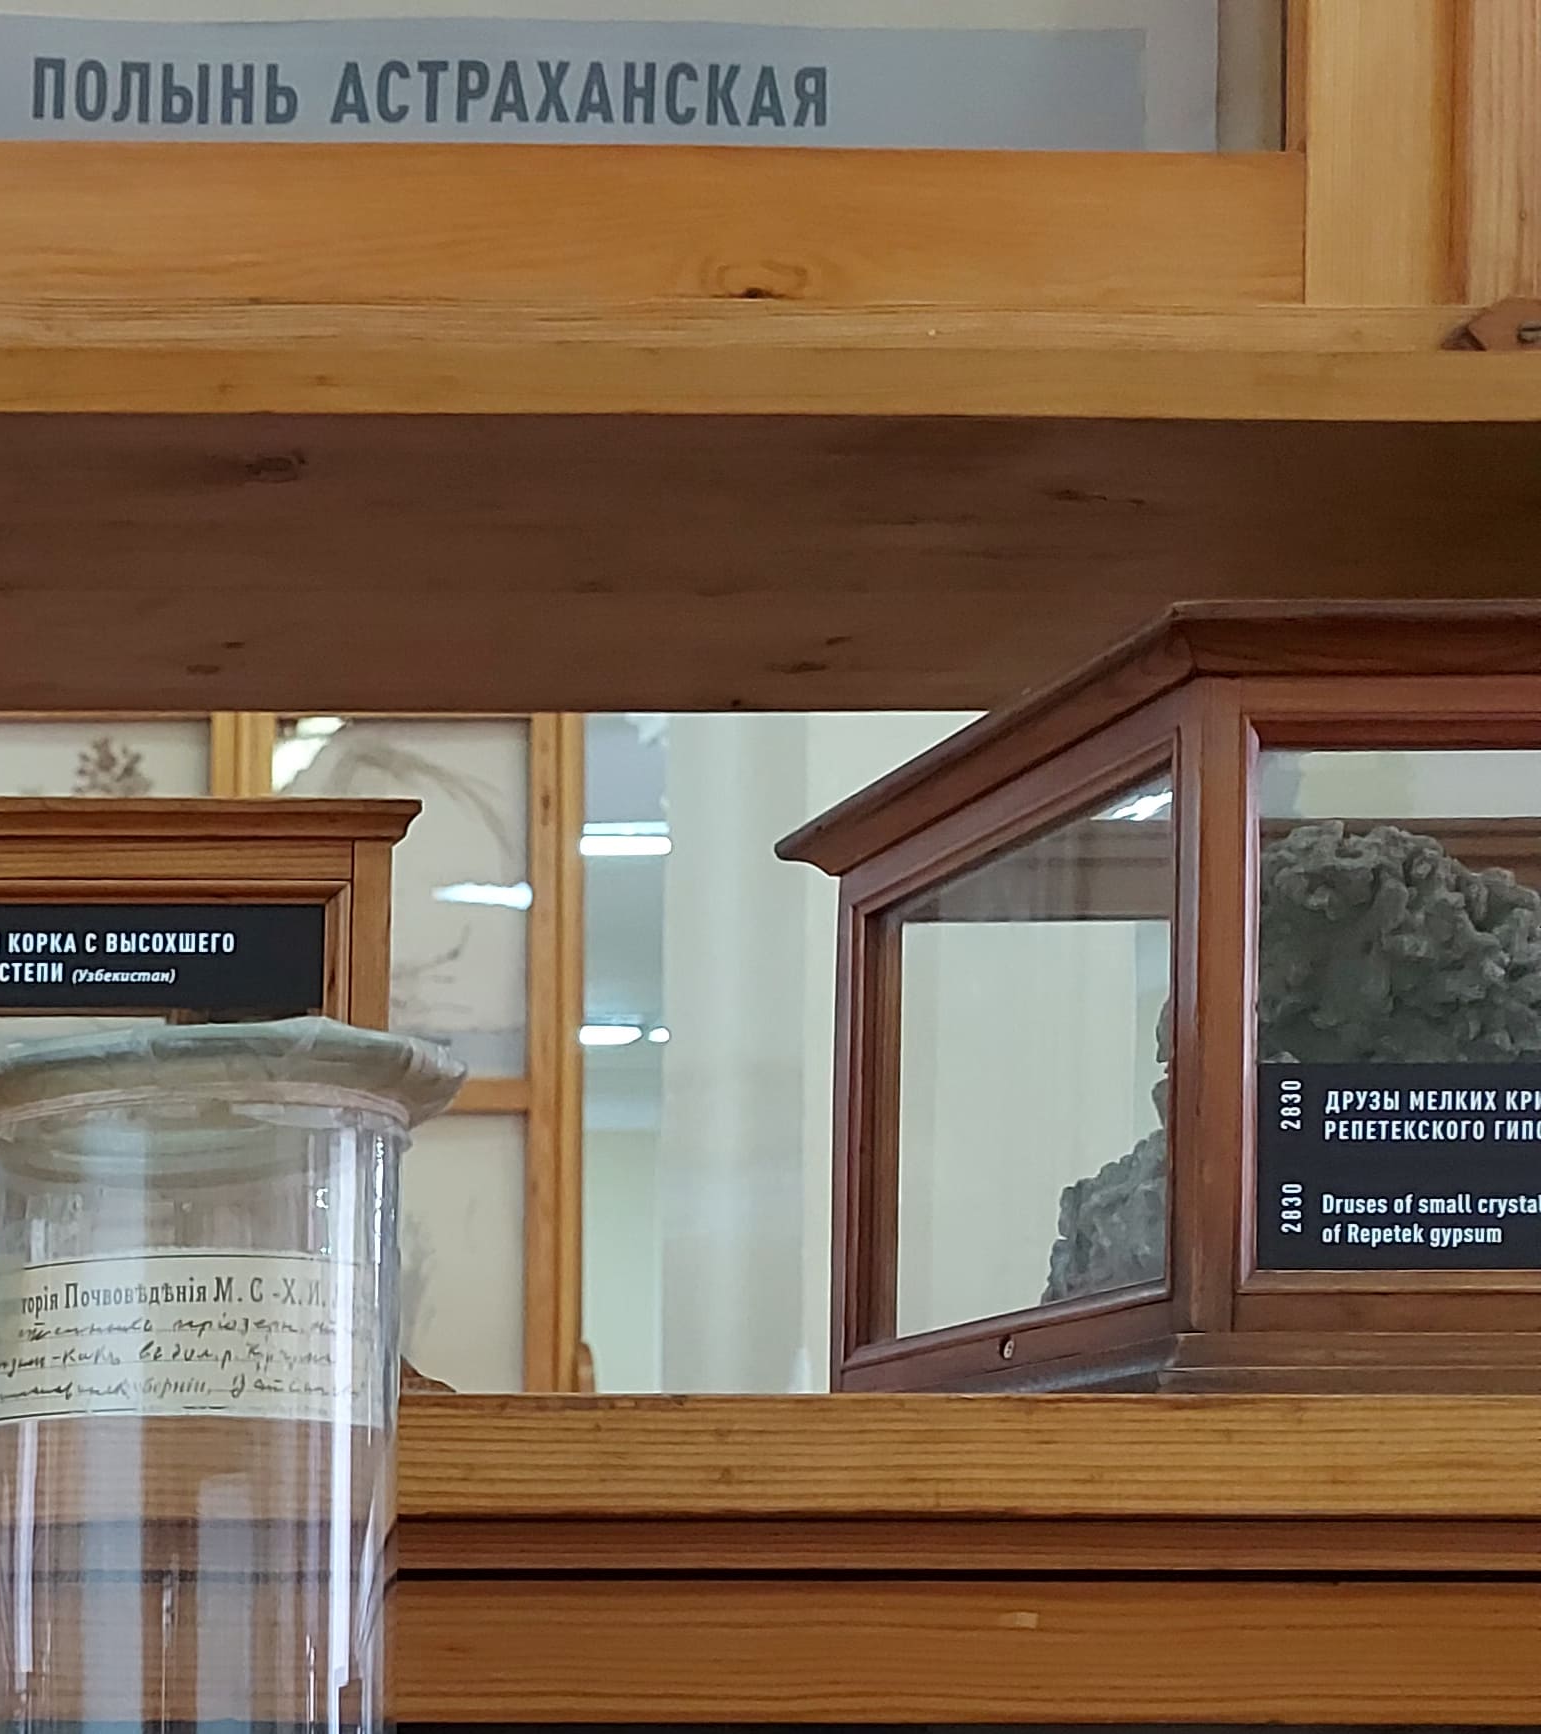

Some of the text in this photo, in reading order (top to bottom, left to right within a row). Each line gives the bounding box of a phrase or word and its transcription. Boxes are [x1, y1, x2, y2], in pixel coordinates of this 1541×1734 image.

[32, 58, 828, 127] ПОЛЫНЬ АСТРАХАНСКАЯ
[9, 933, 76, 953] КОРКА
[86, 933, 96, 952] С
[106, 933, 234, 953] ВЫСОХШЕГО
[0, 963, 63, 982] СТЕПИ
[72, 969, 175, 984] (Узбекистан)
[1281, 1081, 1301, 1129] 2830
[1325, 1091, 1399, 1114] ДРУЗЫ
[1410, 1091, 1496, 1110] МЕЛКИХ
[1325, 1120, 1484, 1140] РЕПЕТЕКСКОГО
[1281, 1184, 1302, 1232] 2830
[1323, 1194, 1387, 1214] Druses
[1394, 1194, 1413, 1213] of
[1418, 1194, 1472, 1213] small
[1323, 1224, 1502, 1247] of Repetek gypsum
[213, 1276, 243, 1303] М.
